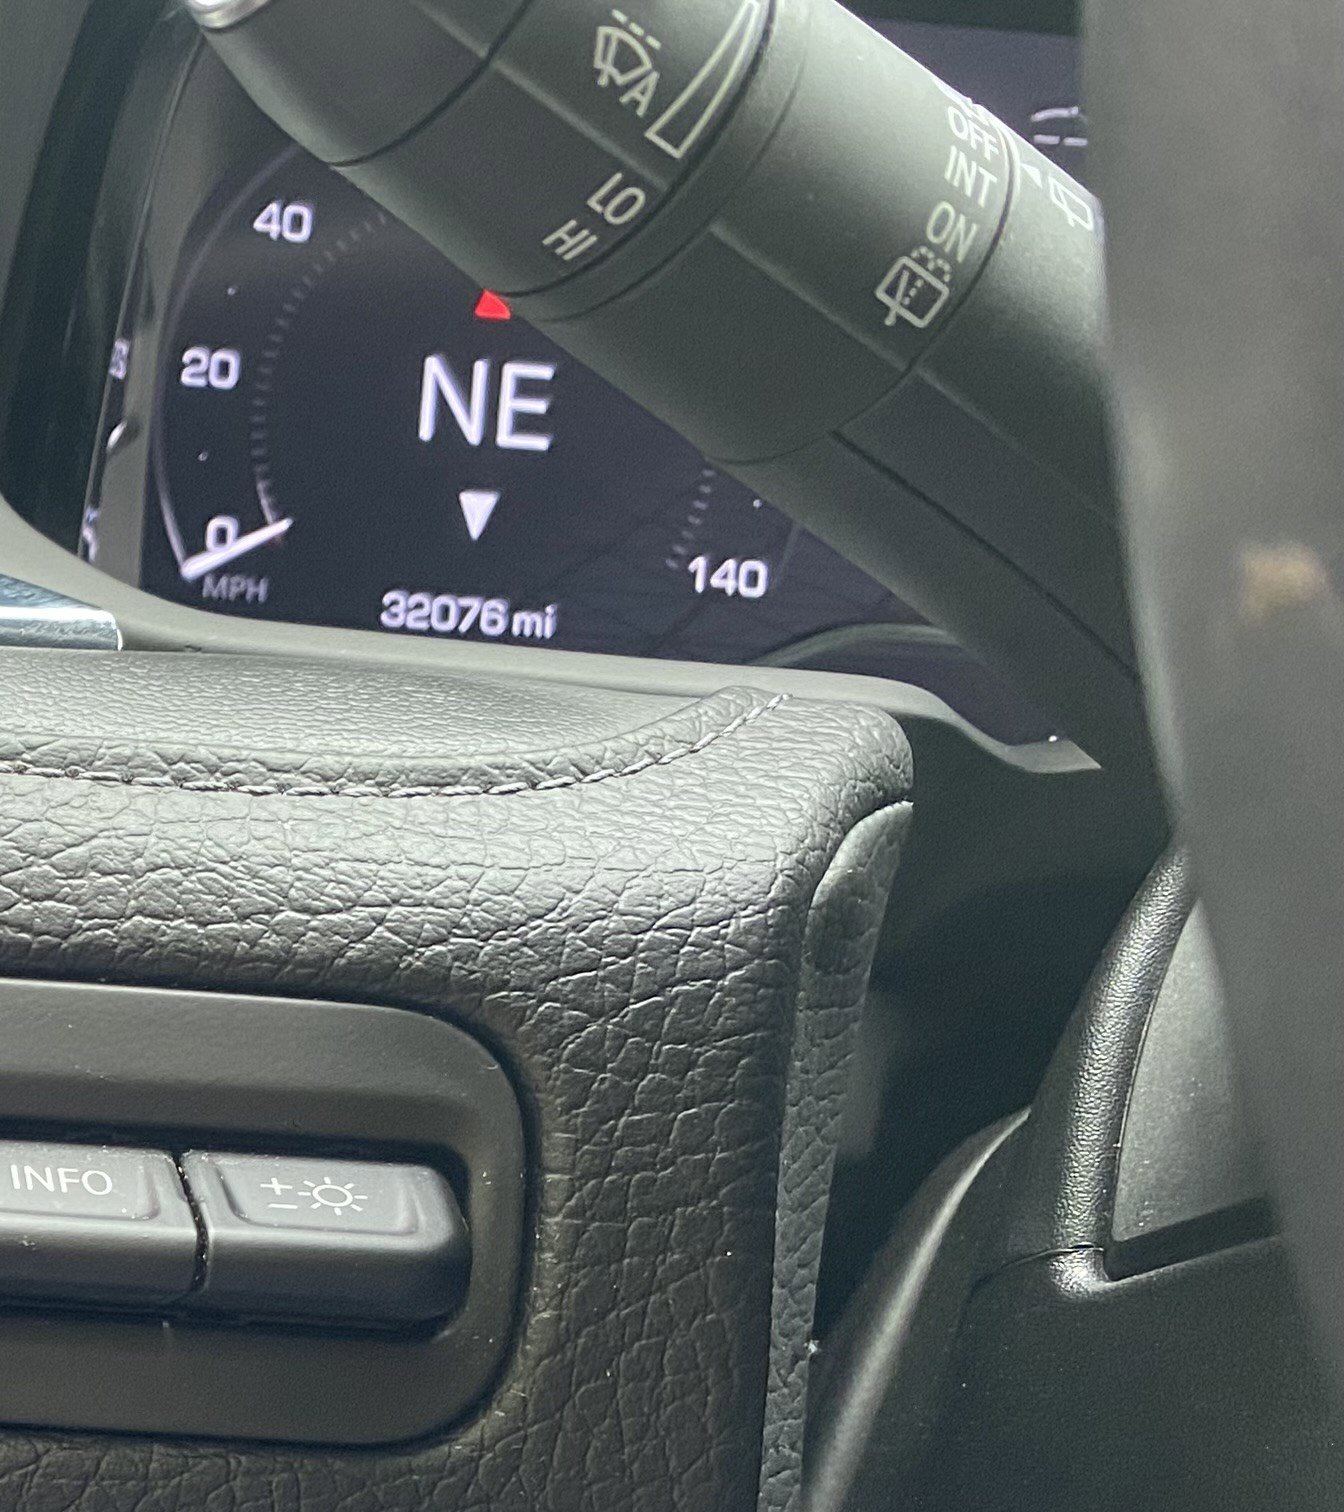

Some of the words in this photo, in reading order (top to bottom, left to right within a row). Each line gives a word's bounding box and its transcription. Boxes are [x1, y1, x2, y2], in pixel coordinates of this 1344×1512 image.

[947, 106, 1000, 161] OFF
[944, 145, 998, 208] INT
[586, 172, 646, 225] LO
[253, 201, 312, 242] 40
[542, 219, 598, 260] HI
[926, 201, 978, 263] ON
[180, 346, 241, 389] 20
[418, 353, 557, 452] NE
[205, 515, 239, 553] 0
[202, 574, 269, 603] MPH
[689, 556, 770, 598] 140
[380, 590, 508, 635] 32076
[512, 604, 558, 638] mi
[9, 1163, 114, 1197] INFO
